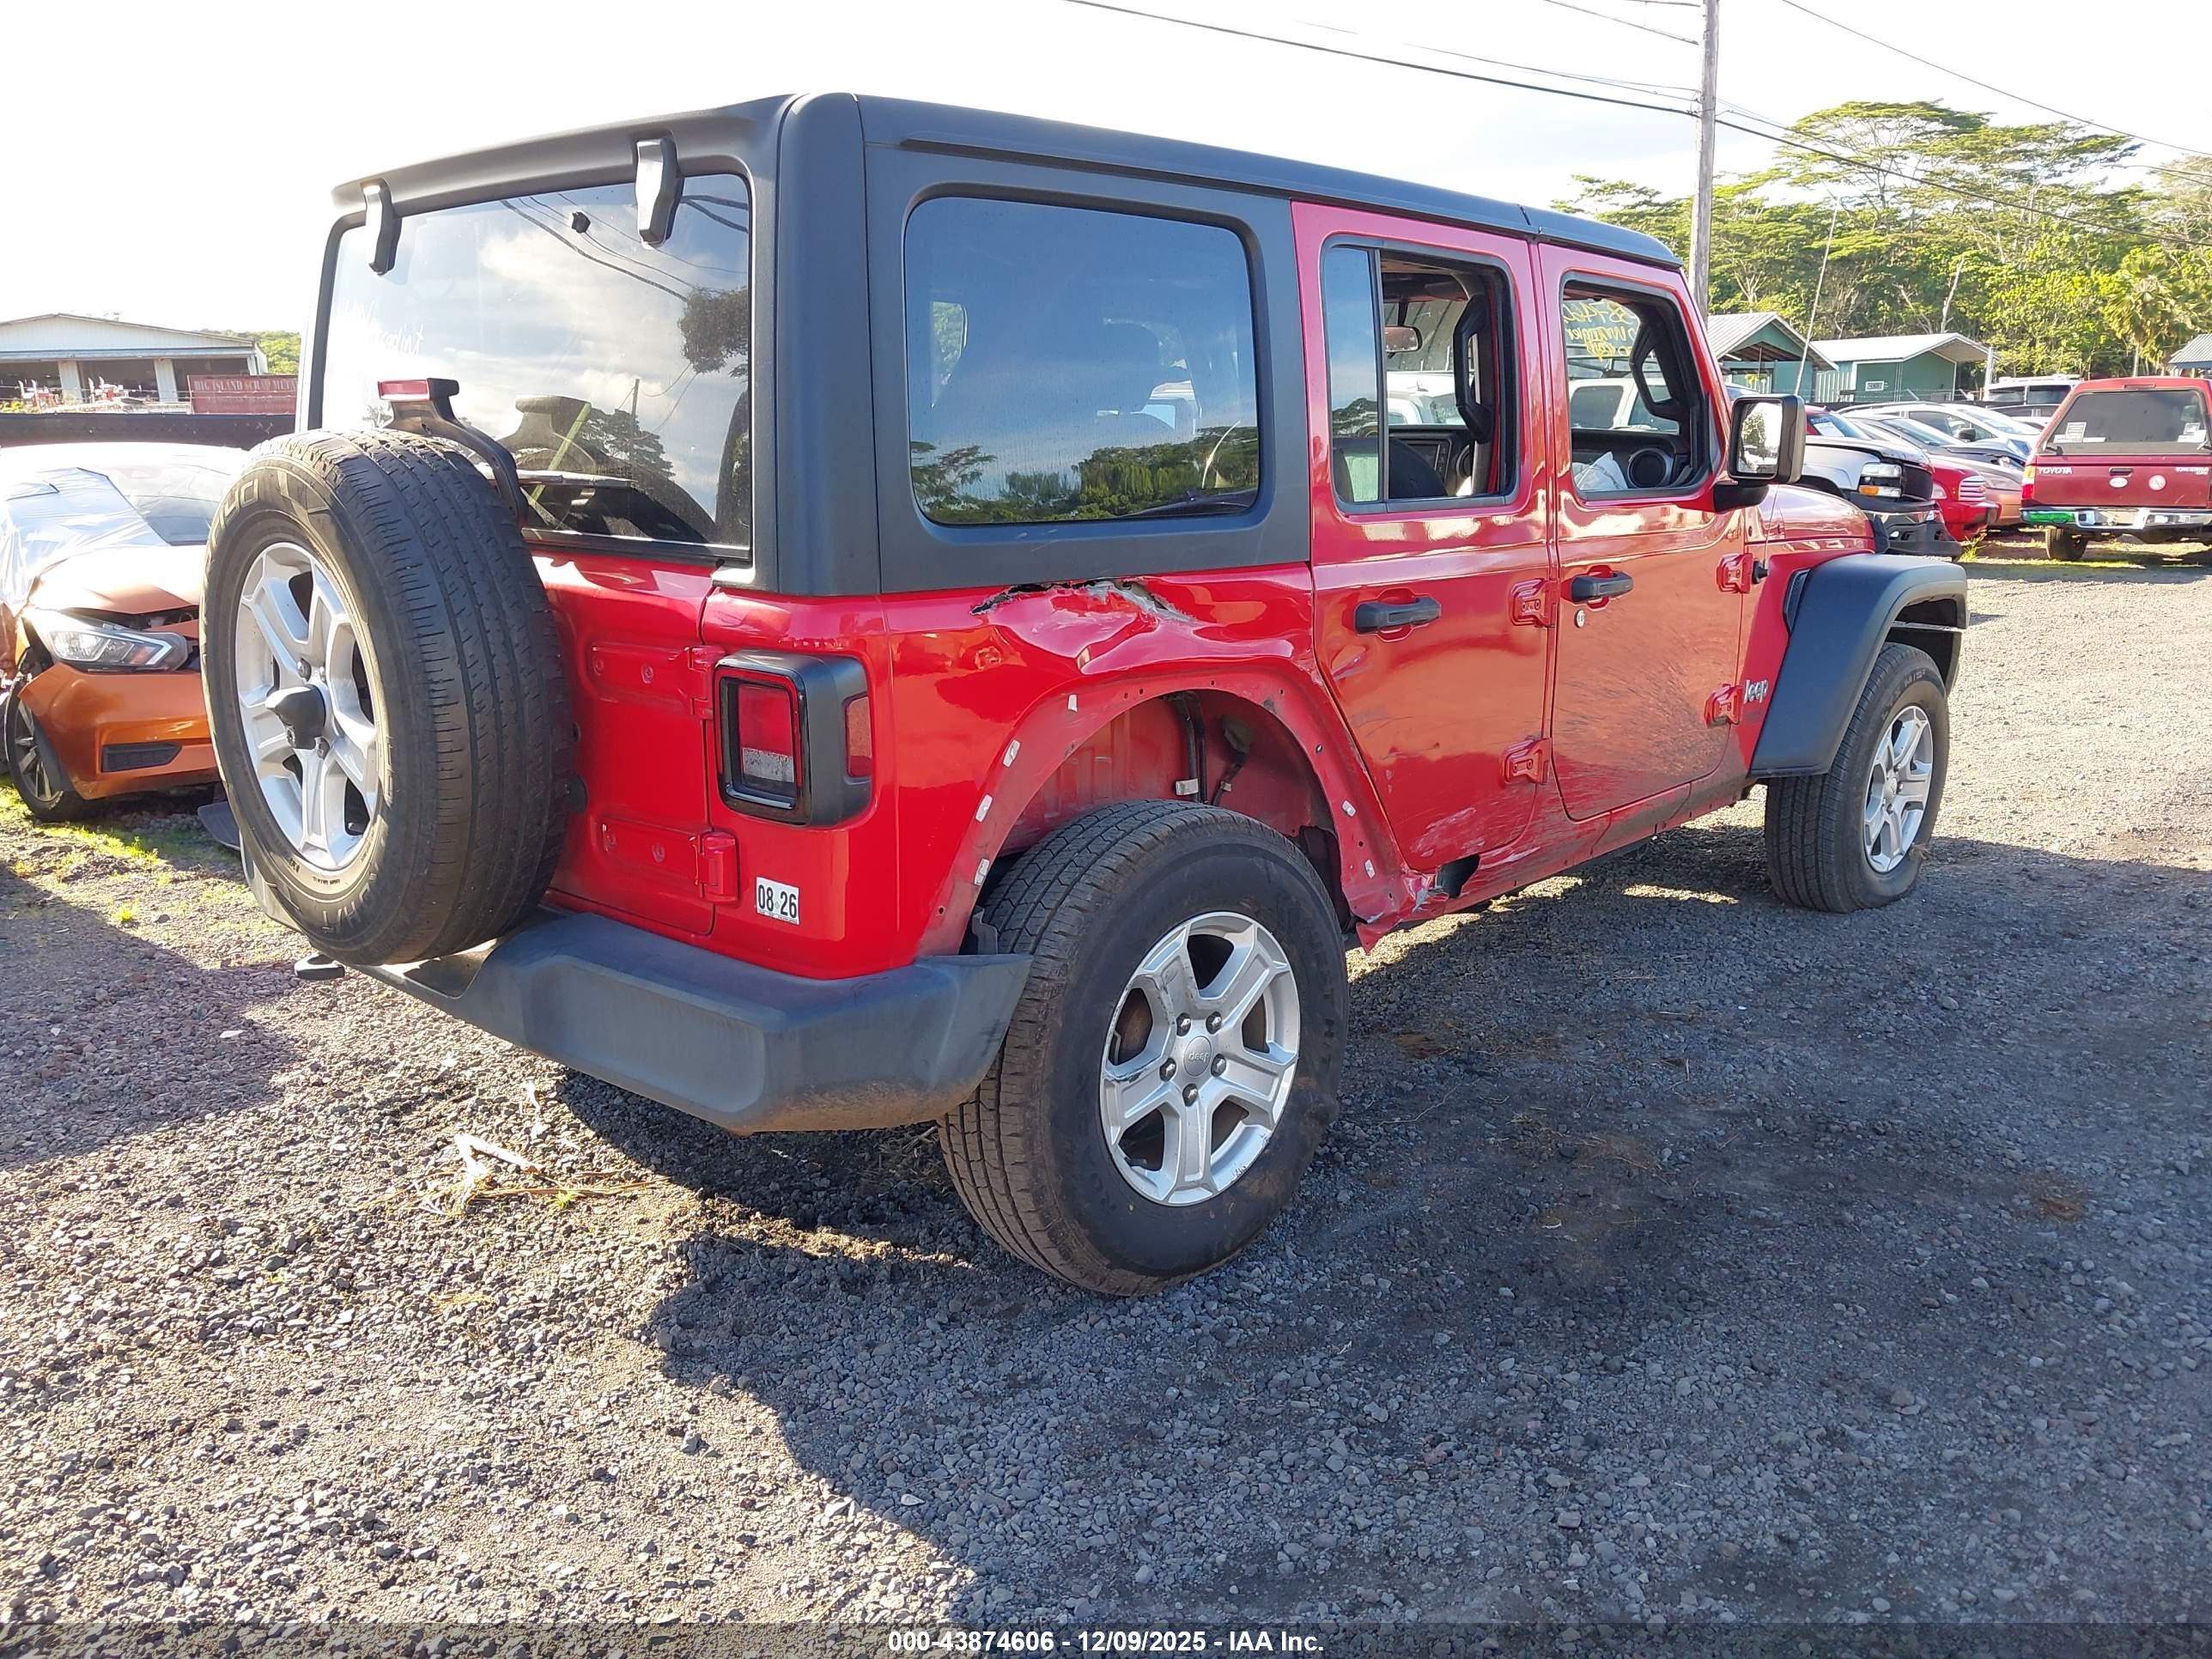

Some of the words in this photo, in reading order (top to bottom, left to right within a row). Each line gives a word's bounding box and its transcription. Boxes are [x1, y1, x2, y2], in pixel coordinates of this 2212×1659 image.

[193, 379, 210, 391] BIG
[212, 380, 243, 391] ISLAND
[273, 379, 296, 391] META
[2038, 466, 2073, 475] TOYOTA
[1744, 679, 1769, 704] Jeep
[758, 884, 775, 912] 08
[780, 890, 797, 919] 26
[1188, 1052, 1209, 1062] Jeep
